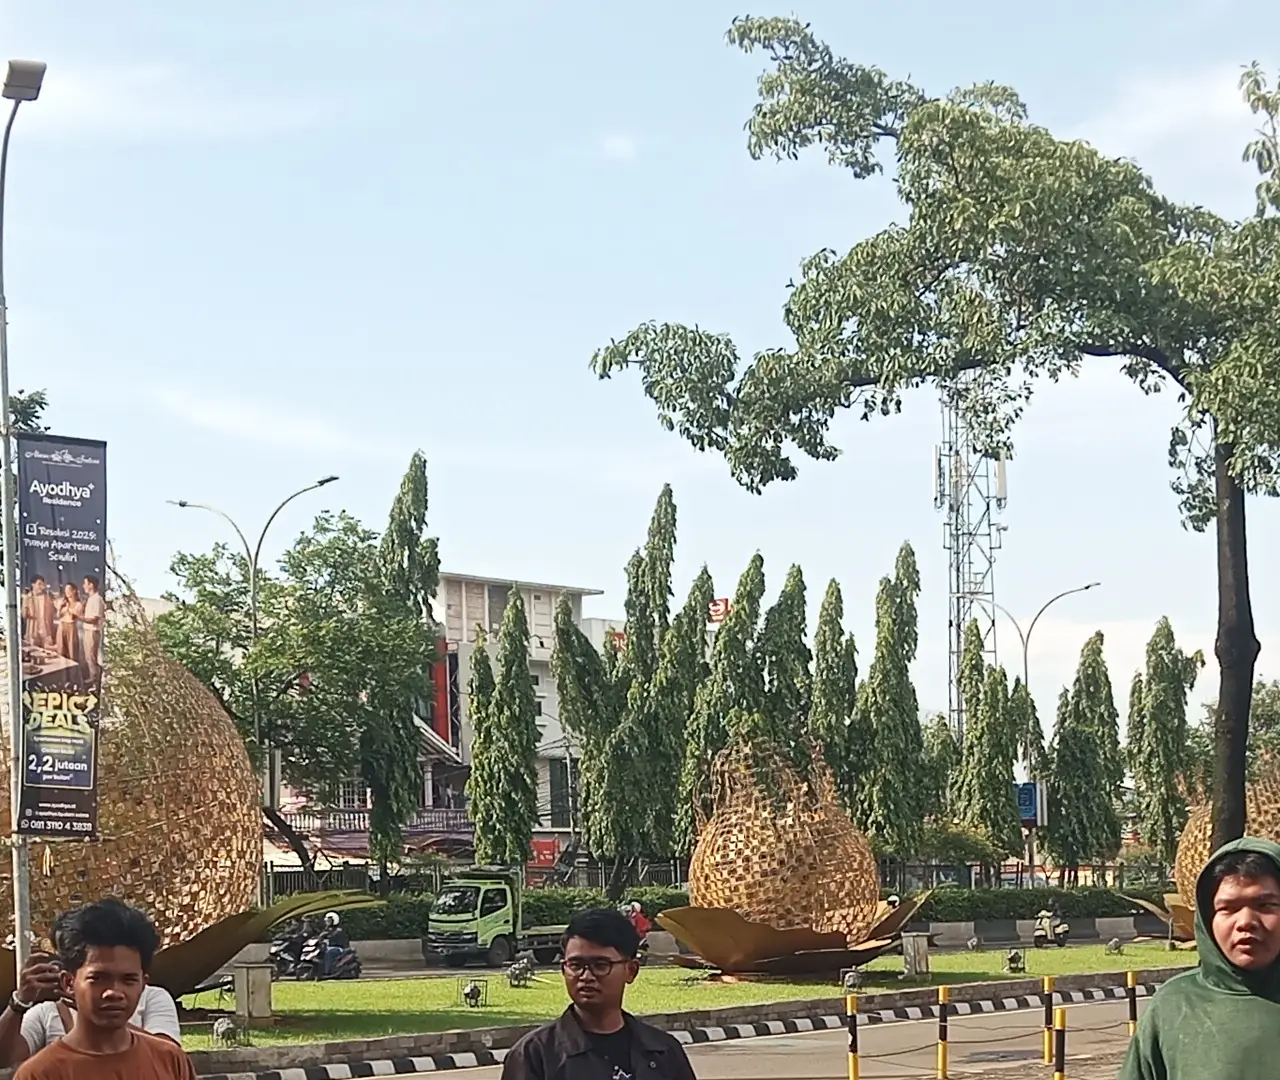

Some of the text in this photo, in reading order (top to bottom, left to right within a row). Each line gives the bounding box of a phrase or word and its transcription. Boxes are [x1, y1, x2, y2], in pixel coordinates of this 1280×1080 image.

[29, 480, 91, 500] Ayodhya
[42, 497, 82, 507] Residence
[32, 692, 86, 715] EPIC
[28, 710, 91, 733] DEALS
[28, 754, 88, 773] 2,2 jutaan
